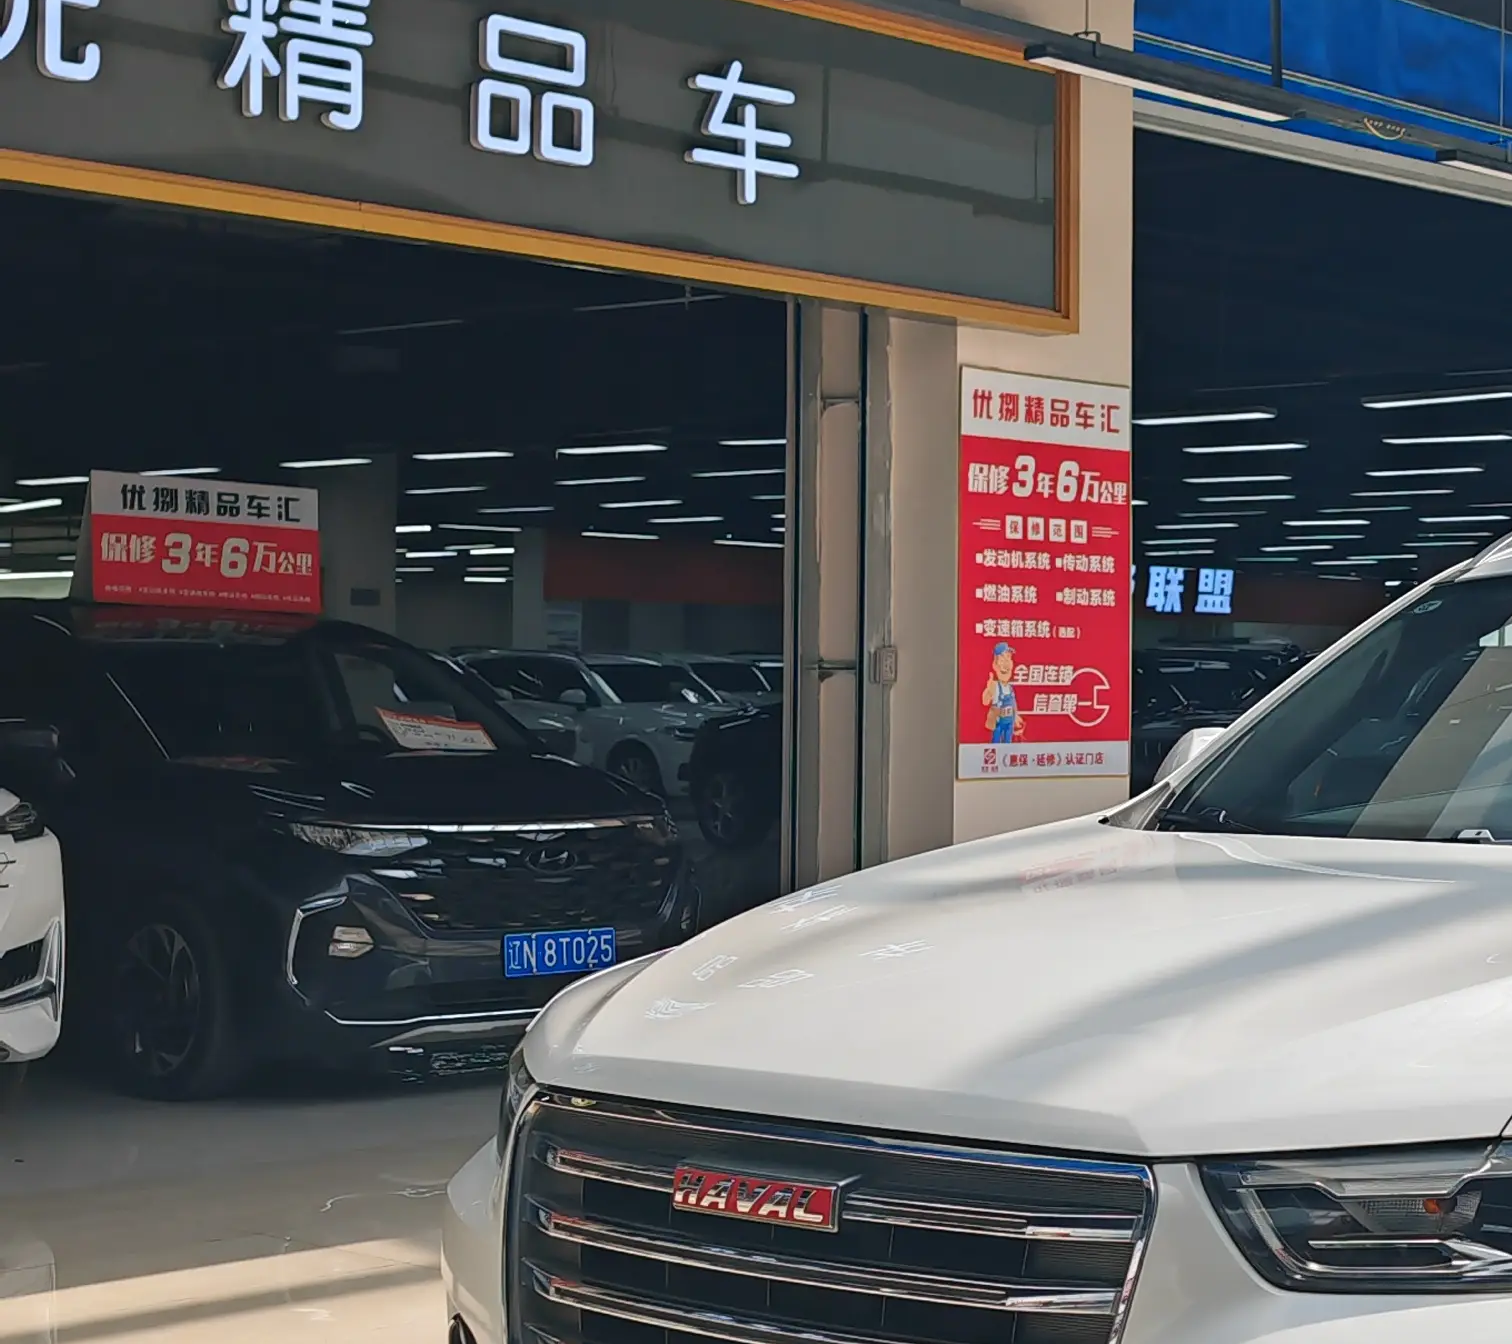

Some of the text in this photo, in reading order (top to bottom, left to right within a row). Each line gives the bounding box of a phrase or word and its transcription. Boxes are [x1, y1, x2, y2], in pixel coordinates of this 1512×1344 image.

[973, 389, 1120, 434] 优捌精品车汇
[968, 454, 1127, 505] 保修3年6万公里
[121, 484, 300, 523] 优捌精品车汇
[101, 533, 312, 579] 保修3年6万公里
[984, 549, 1116, 574] 发动机系统 传动系统
[984, 584, 1116, 606] 燃油系统 制动系统
[1013, 665, 1074, 683] 全国连锁
[674, 1172, 823, 1223] HAVAL
